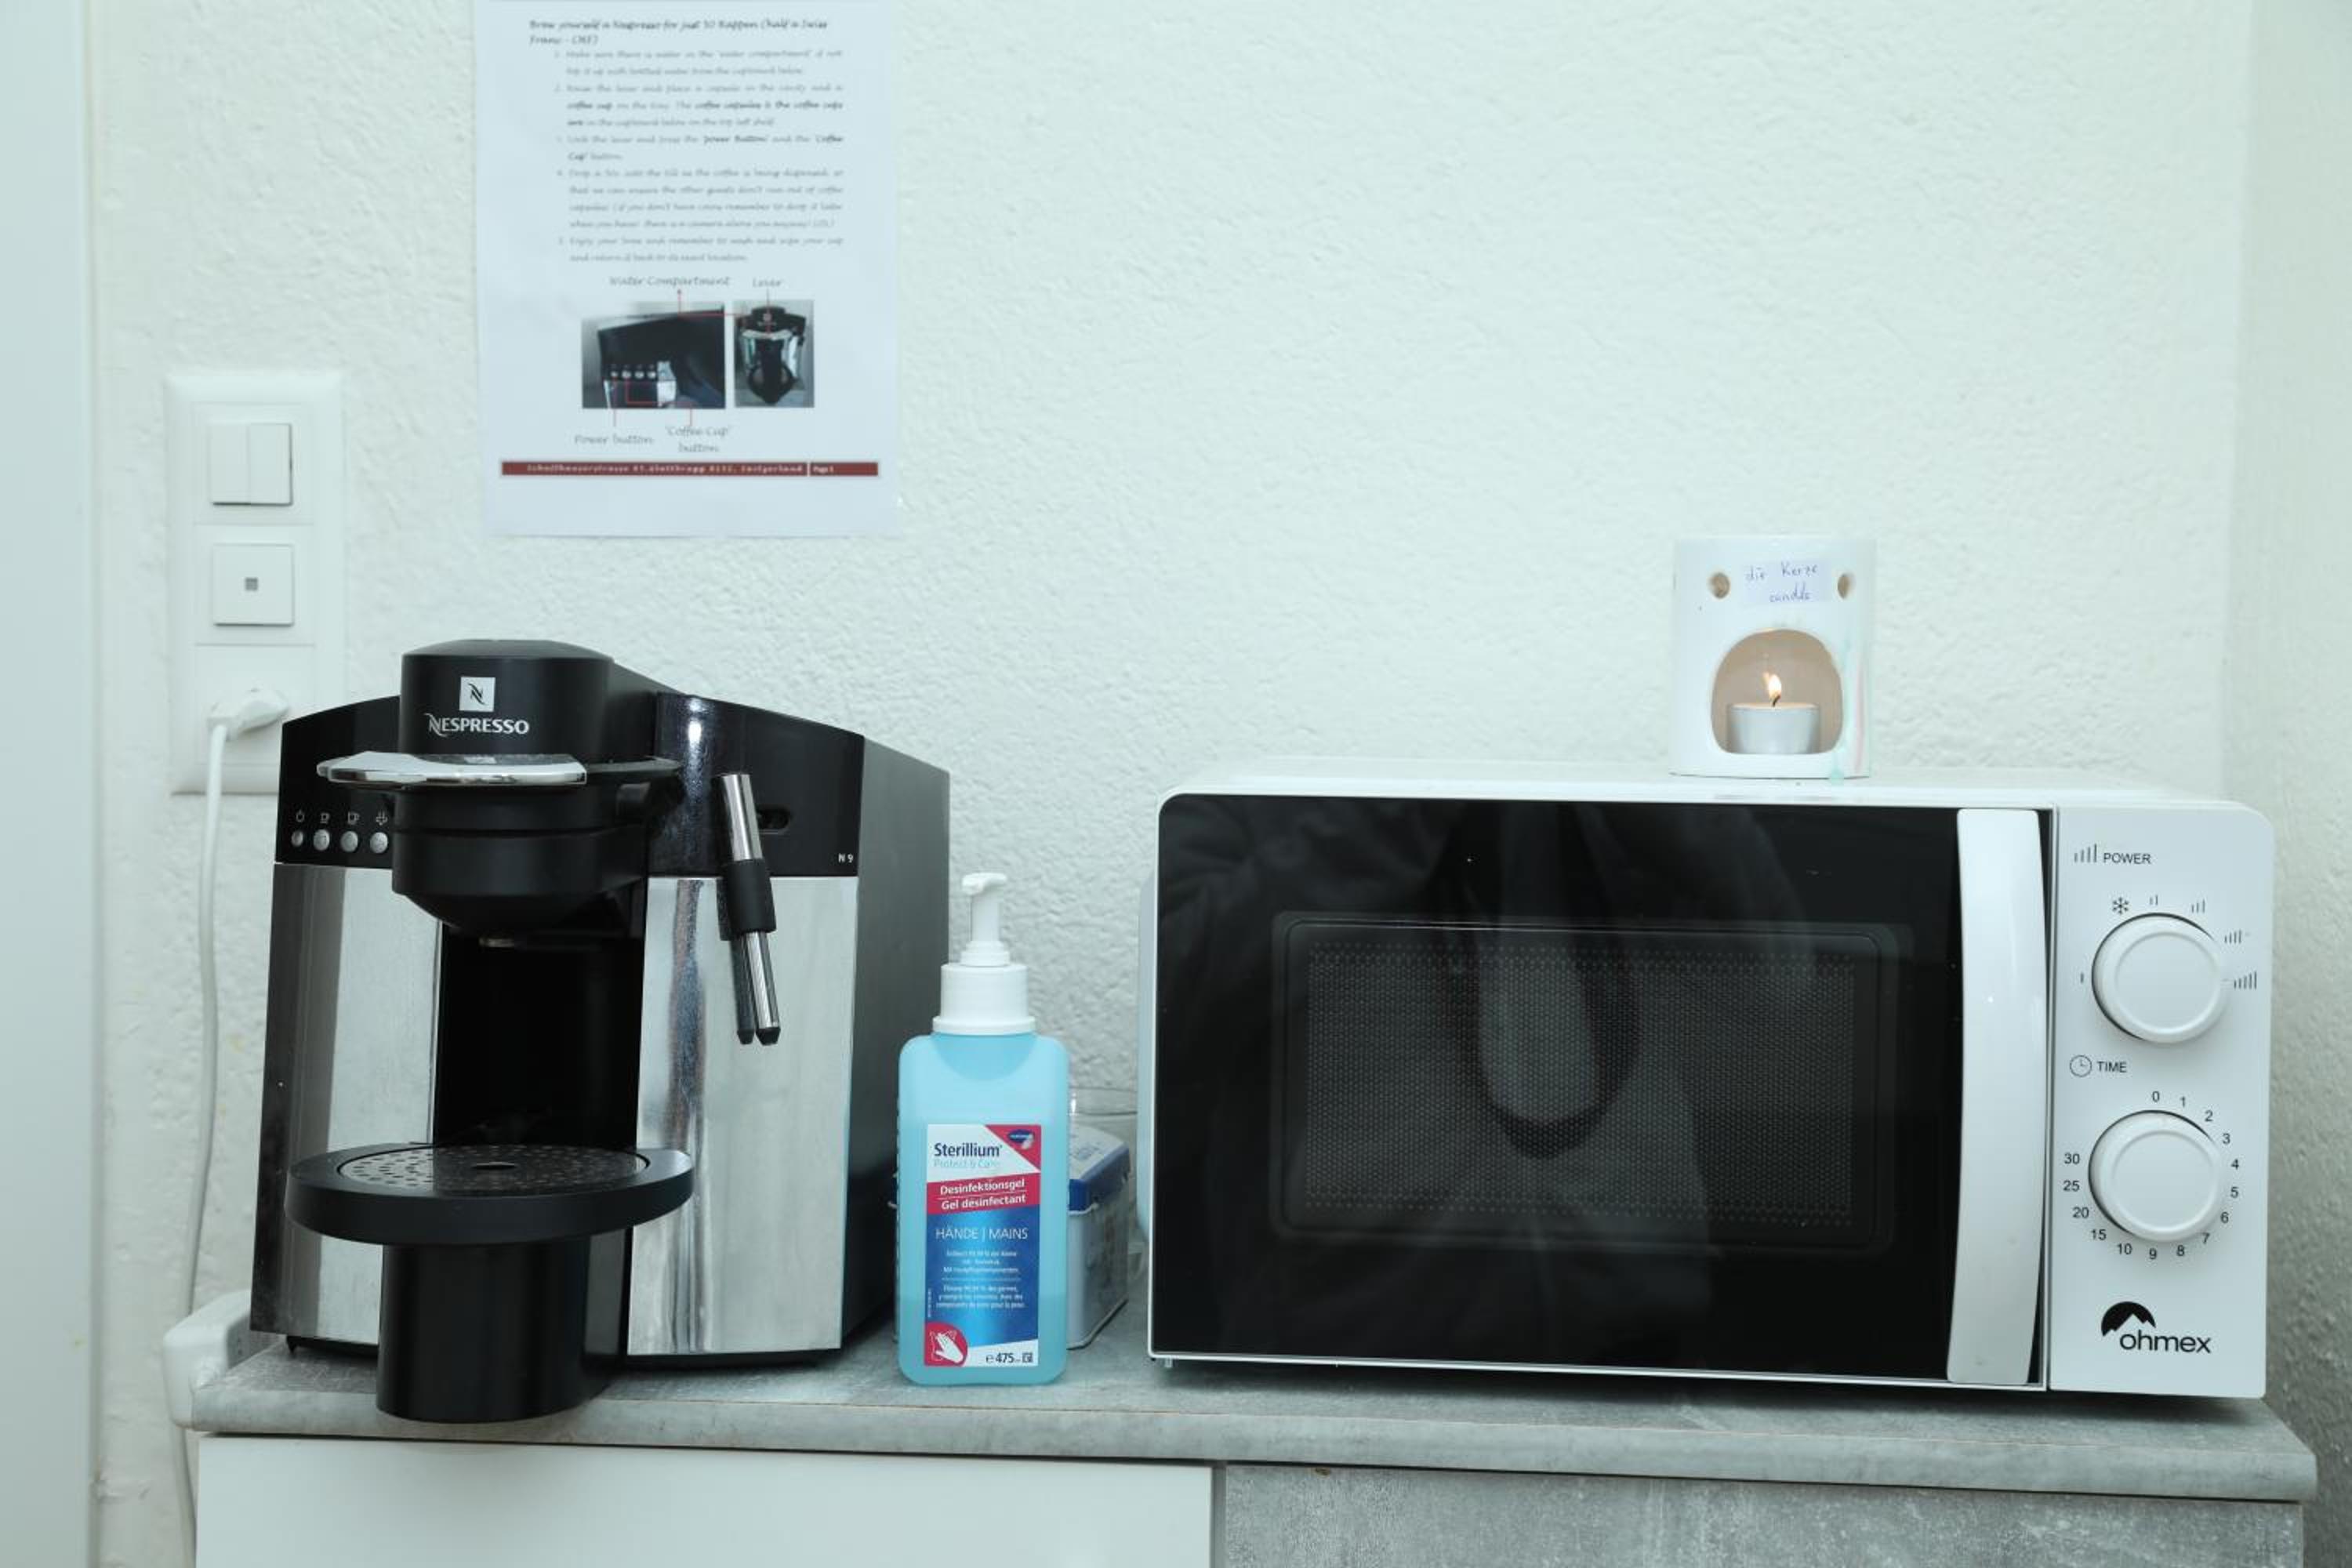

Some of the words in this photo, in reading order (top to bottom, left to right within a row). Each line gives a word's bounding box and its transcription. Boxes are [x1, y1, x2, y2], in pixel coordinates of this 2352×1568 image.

[423, 713, 530, 738] NESPRESSO
[2103, 853, 2152, 864] POWER
[2097, 1061, 2128, 1073] TIME
[2152, 1091, 2159, 1102] 0
[2180, 1097, 2185, 1106] 1
[2205, 1111, 2213, 1121] 2
[2223, 1134, 2230, 1145] 3
[2064, 1154, 2080, 1164] 30
[2231, 1160, 2239, 1170] 4
[940, 1177, 1025, 1196] Desinfektionsgel
[2063, 1181, 2080, 1192] 25
[2230, 1187, 2238, 1198] 5
[942, 1198, 959, 1210] Gel
[2073, 1207, 2089, 1218] 20
[2220, 1212, 2229, 1223] 6
[935, 1225, 979, 1240] HÄNDE
[989, 1226, 1029, 1240] MAINS
[2091, 1229, 2107, 1240] 15
[2203, 1233, 2210, 1244] 7
[2118, 1243, 2132, 1254] 10
[2149, 1248, 2157, 1259] 9
[2177, 1245, 2184, 1256] 8
[2119, 1329, 2211, 1354] ohmex
[995, 1352, 1014, 1363] 475
